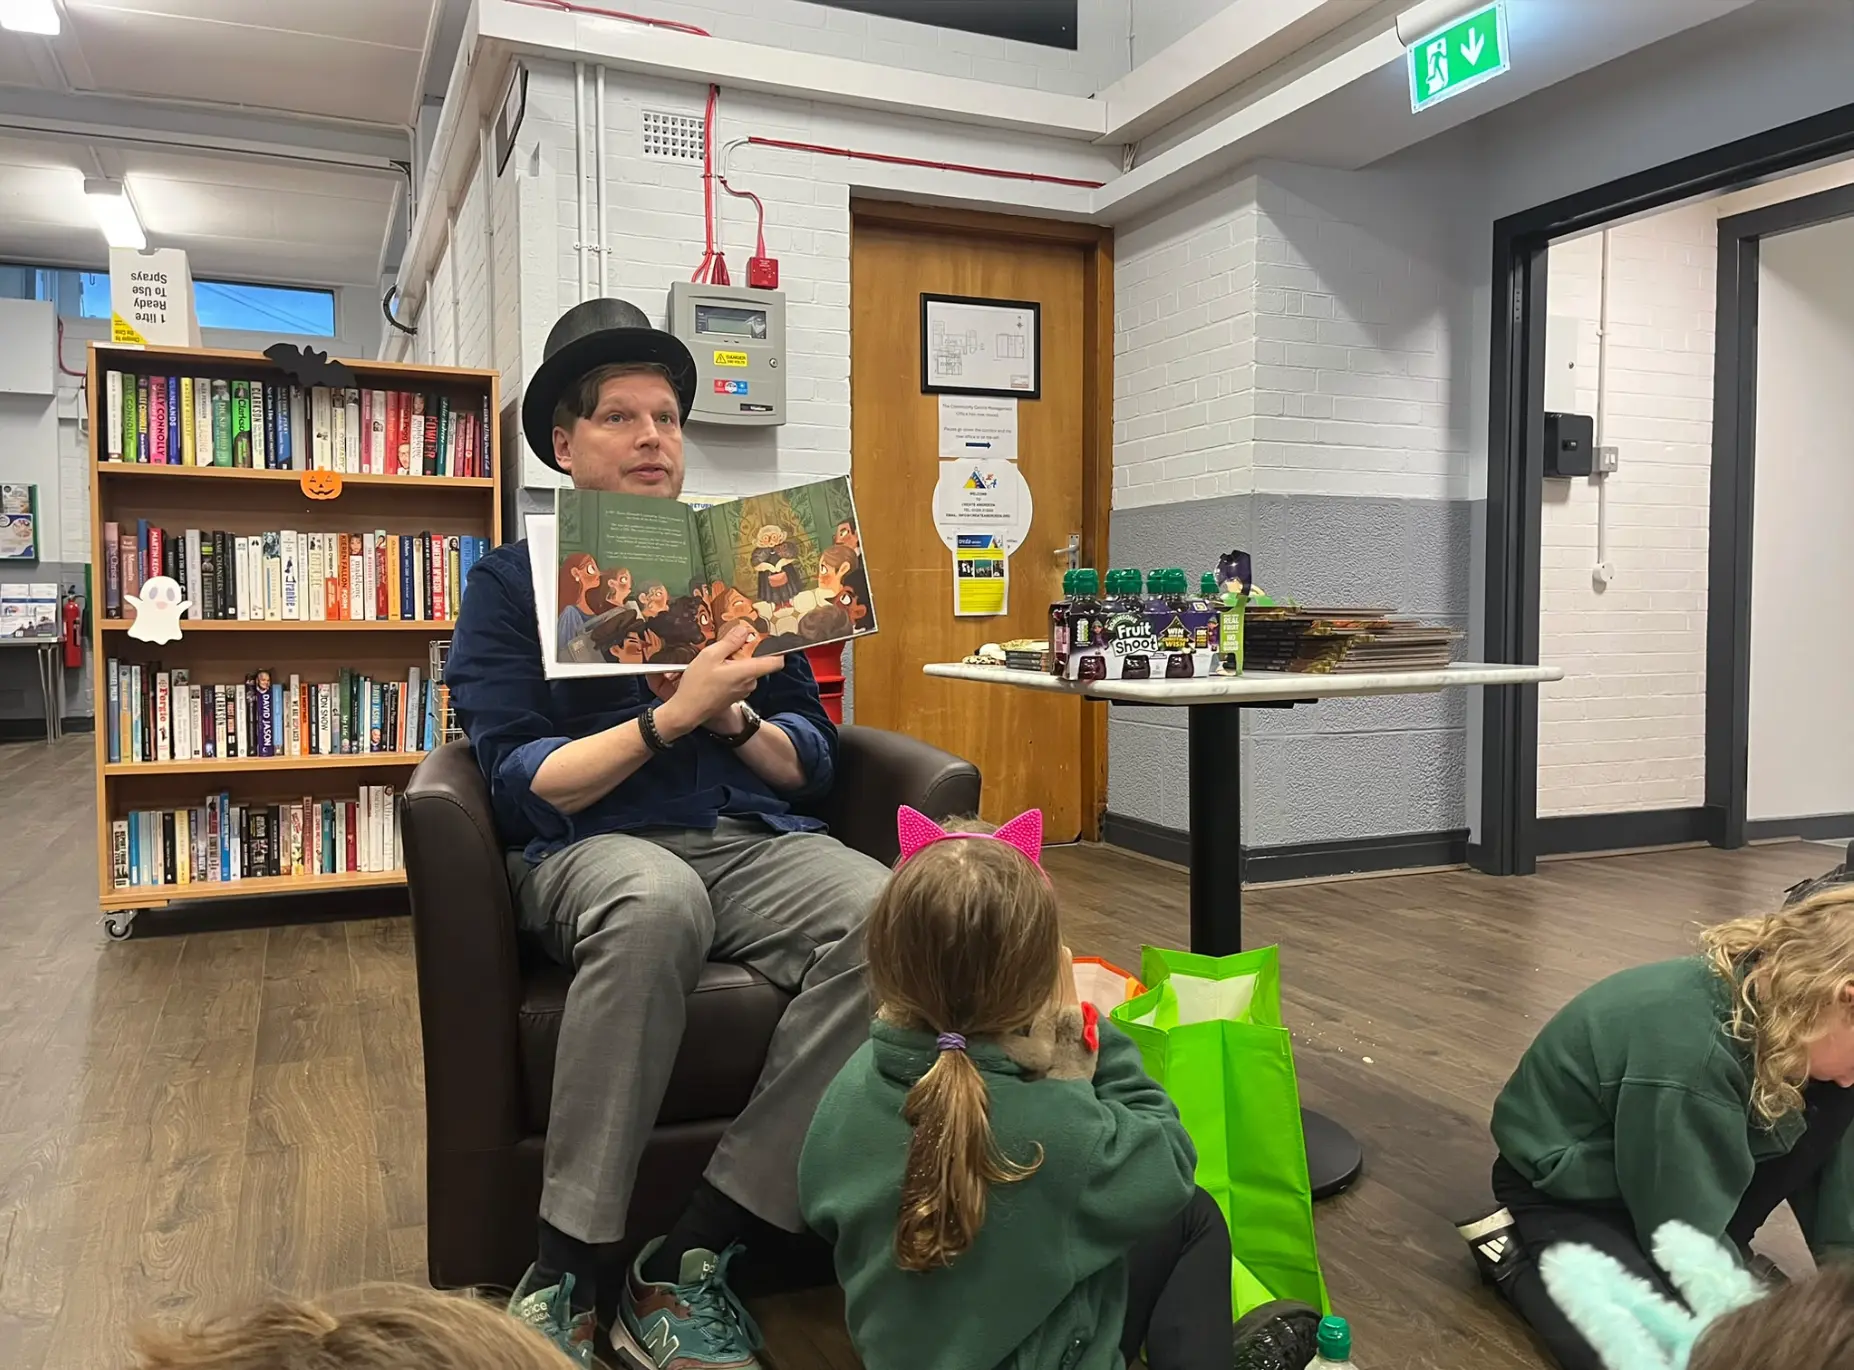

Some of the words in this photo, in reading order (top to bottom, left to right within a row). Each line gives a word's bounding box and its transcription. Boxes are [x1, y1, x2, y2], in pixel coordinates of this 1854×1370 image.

[131, 272, 167, 283] Sprays
[133, 287, 151, 296] Use
[155, 288, 167, 296] To
[134, 298, 166, 310] Ready
[135, 313, 156, 323] litre
[161, 314, 166, 323] 1
[252, 388, 262, 423] CLARKSON
[425, 416, 437, 458] FOWLER
[432, 540, 441, 567] CAMERON
[1108, 613, 1138, 630] ROBINSONS
[1117, 622, 1151, 638] Fruit
[1116, 639, 1156, 653] Shoot
[216, 692, 225, 726] CLARKSON
[342, 715, 348, 724] My
[262, 720, 271, 746] JASON
